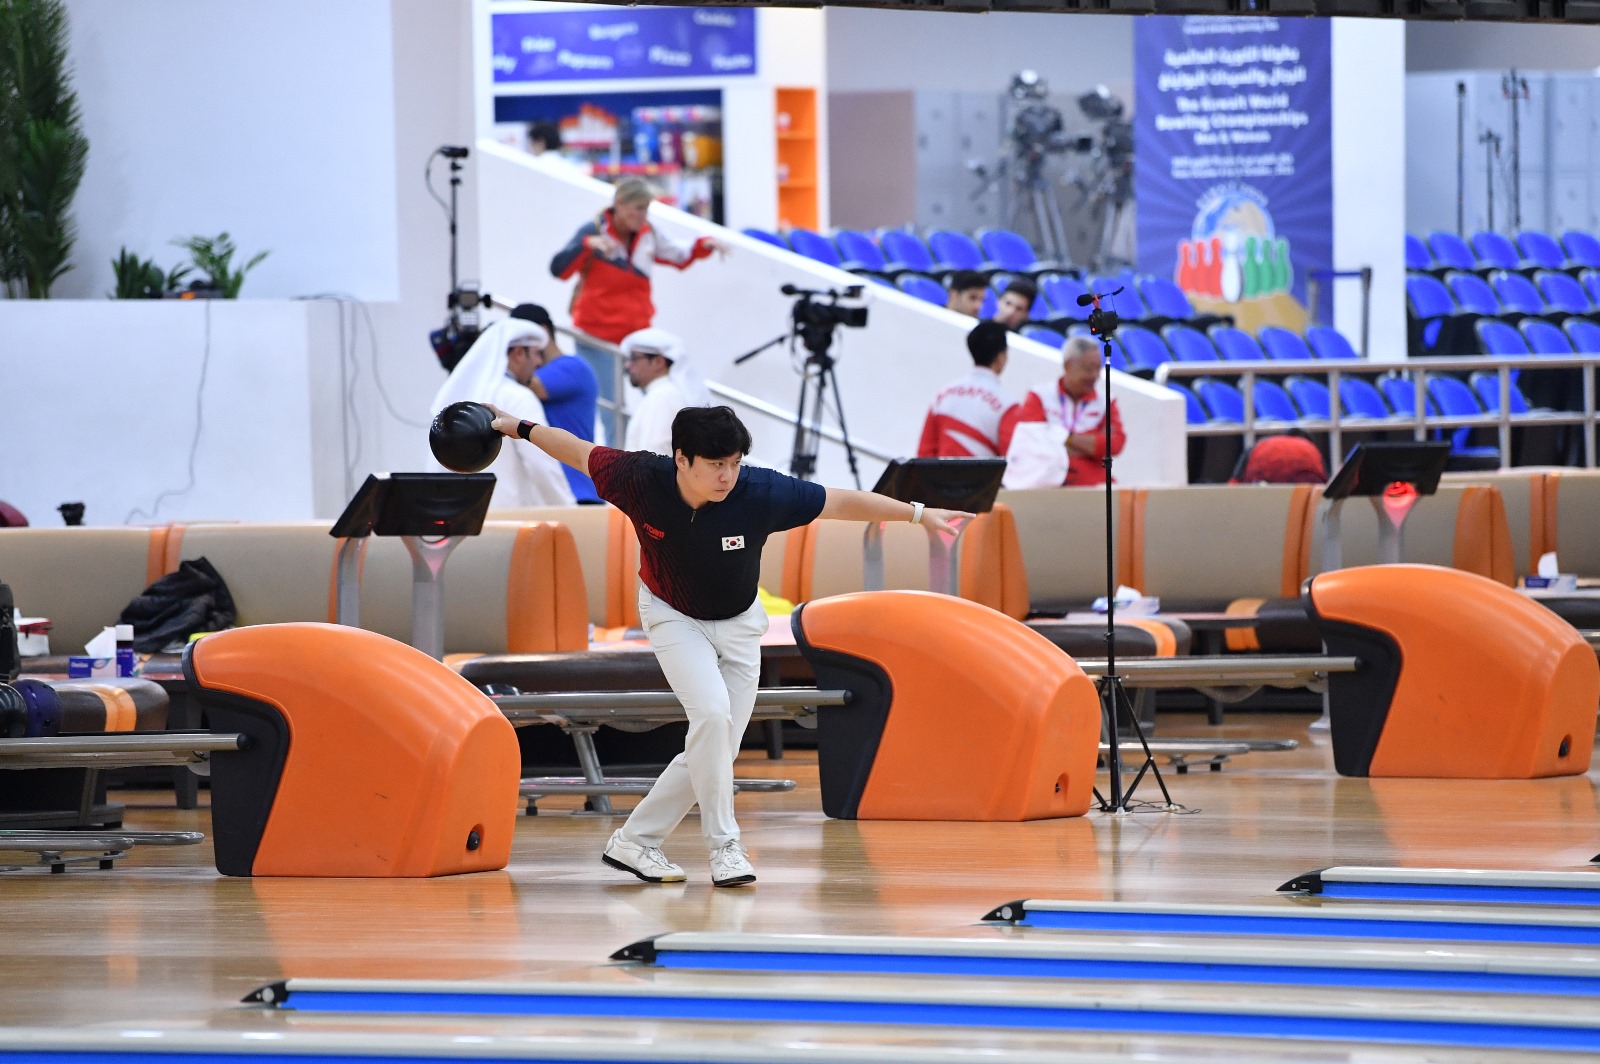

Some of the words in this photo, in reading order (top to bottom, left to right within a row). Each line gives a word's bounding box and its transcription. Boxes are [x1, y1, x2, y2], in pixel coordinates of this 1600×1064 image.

[1200, 95, 1247, 111] Kuwait
[1248, 93, 1289, 109] World
[1156, 114, 1210, 131] Bowling
[1210, 111, 1309, 129] Championships
